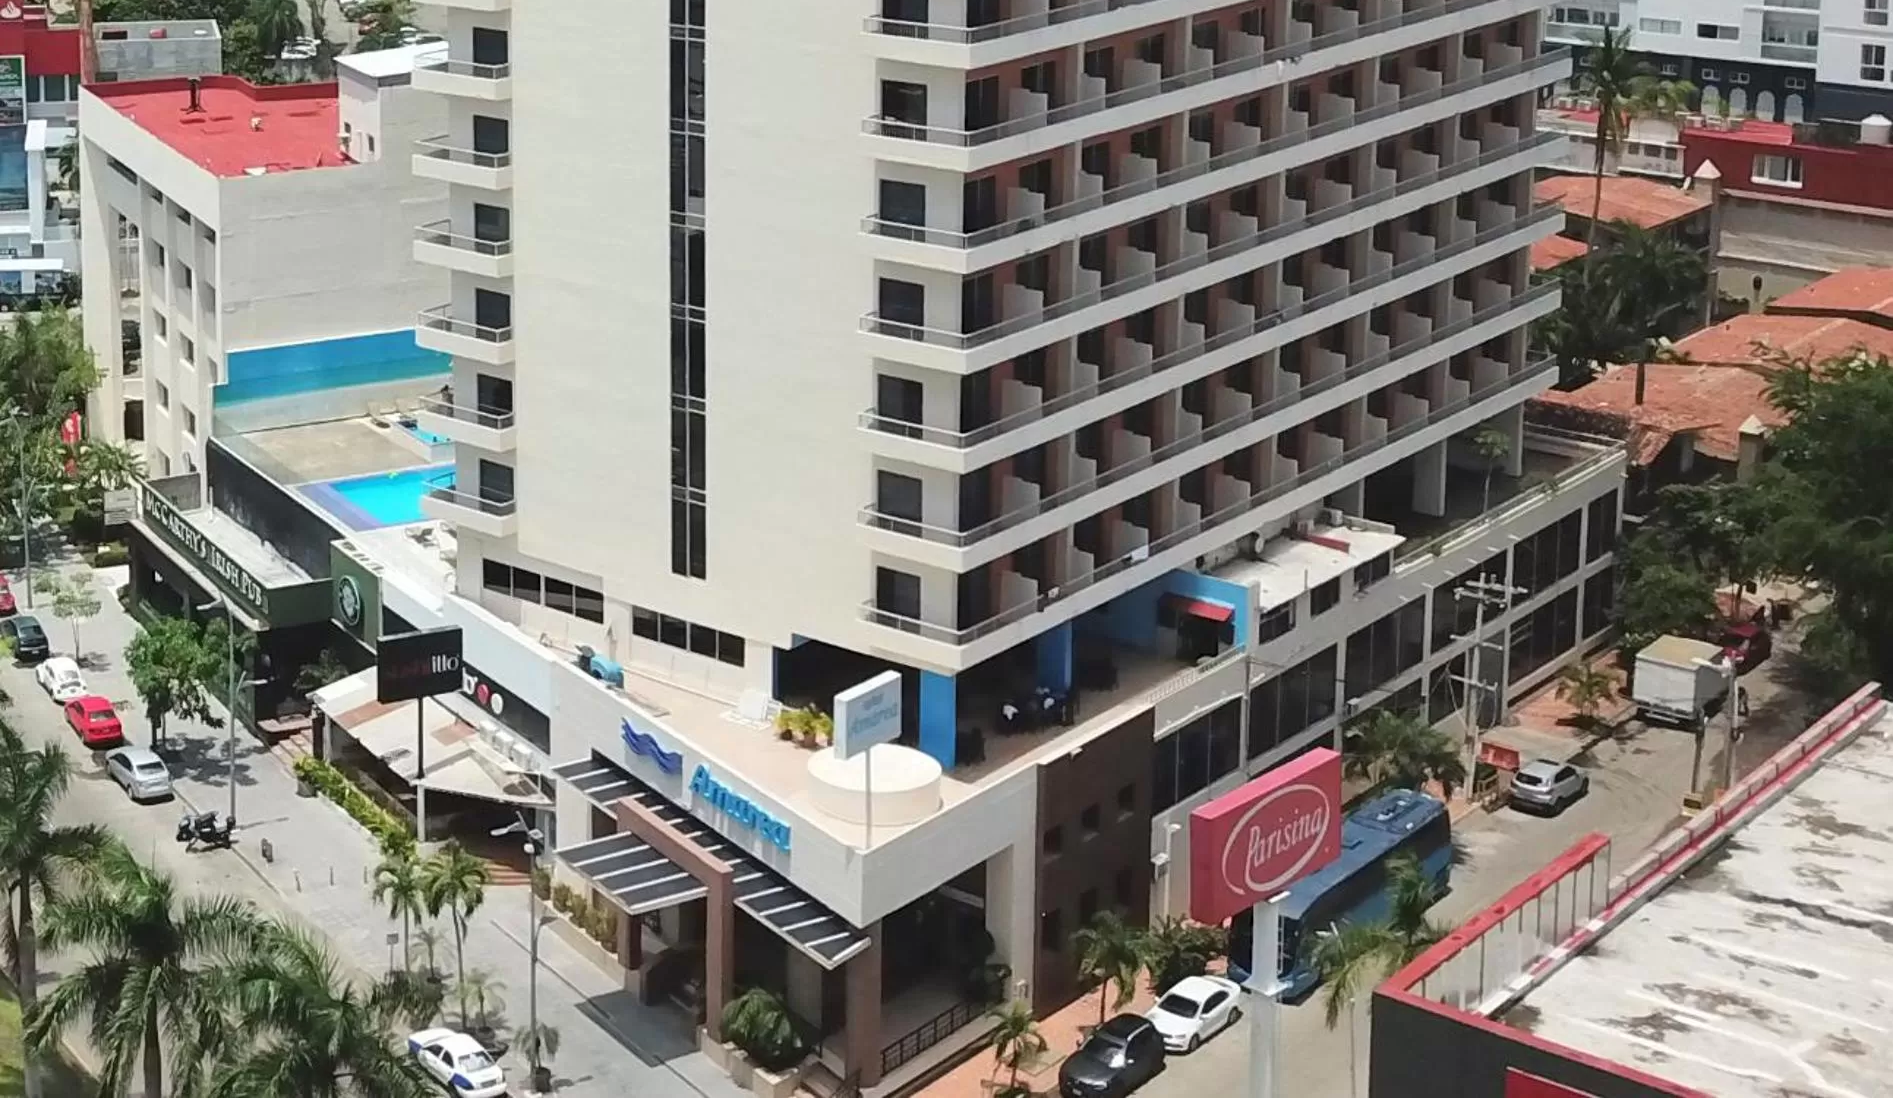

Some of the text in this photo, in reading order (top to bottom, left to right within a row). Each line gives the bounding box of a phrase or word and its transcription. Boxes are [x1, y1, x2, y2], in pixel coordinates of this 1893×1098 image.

[211, 546, 239, 587] IRISH
[240, 571, 262, 605] PUB
[1249, 806, 1323, 867] Parisina
